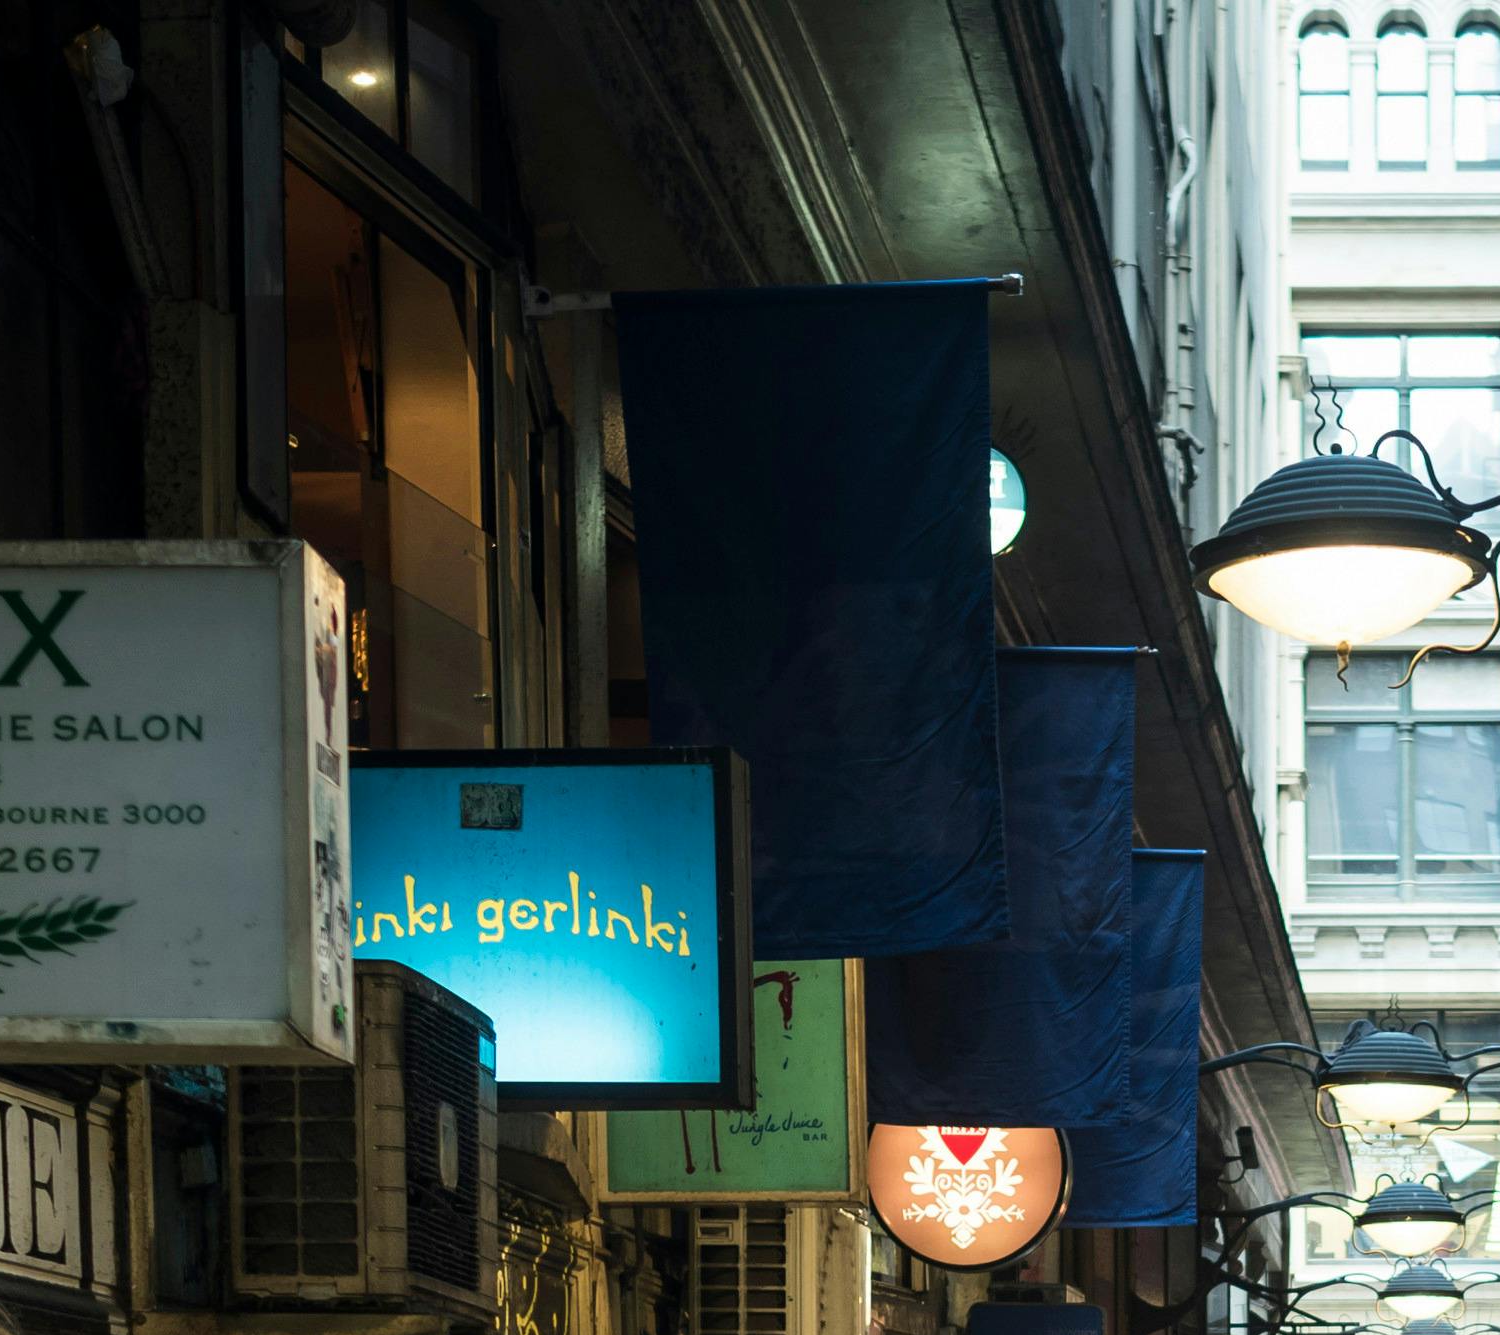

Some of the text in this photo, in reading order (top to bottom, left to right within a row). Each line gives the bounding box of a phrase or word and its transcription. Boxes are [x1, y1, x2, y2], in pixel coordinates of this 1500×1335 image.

[53, 714, 206, 743] SALON
[122, 803, 207, 826] 3000
[476, 870, 691, 957] gerlinki
[728, 1110, 823, 1146] Jungle Juice
[802, 1132, 829, 1142] BAR
